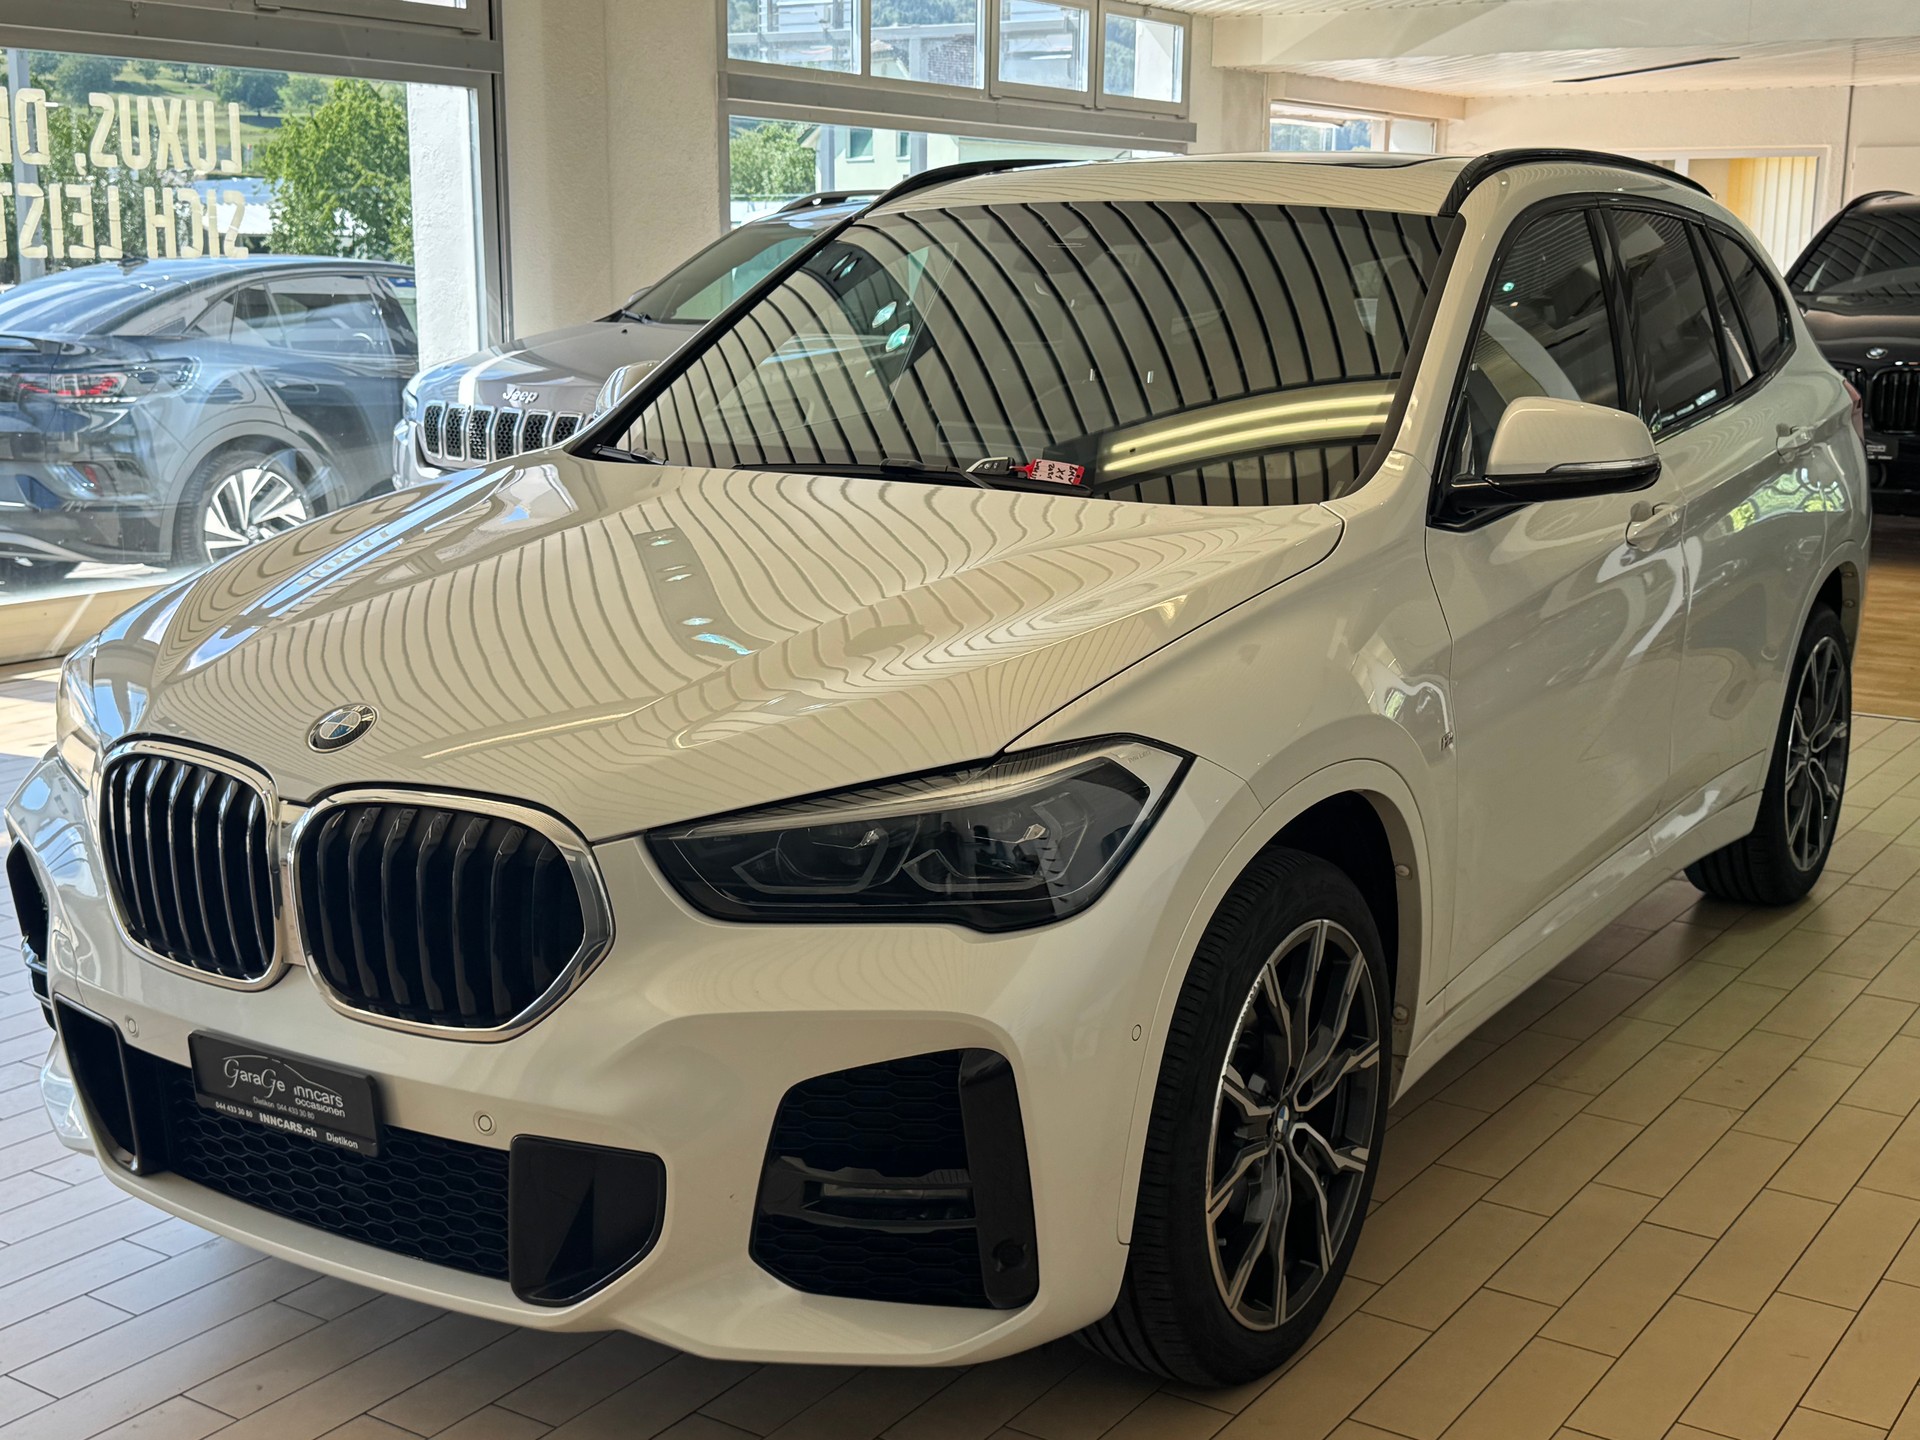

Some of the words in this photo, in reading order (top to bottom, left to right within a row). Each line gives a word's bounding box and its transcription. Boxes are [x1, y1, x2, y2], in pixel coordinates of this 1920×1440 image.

[502, 388, 539, 404] Jeep
[224, 1059, 285, 1098] GaraGe
[294, 1085, 343, 1107] inncars
[259, 1112, 318, 1138] INNCARS.ch
[325, 1131, 360, 1150] Dietikon
